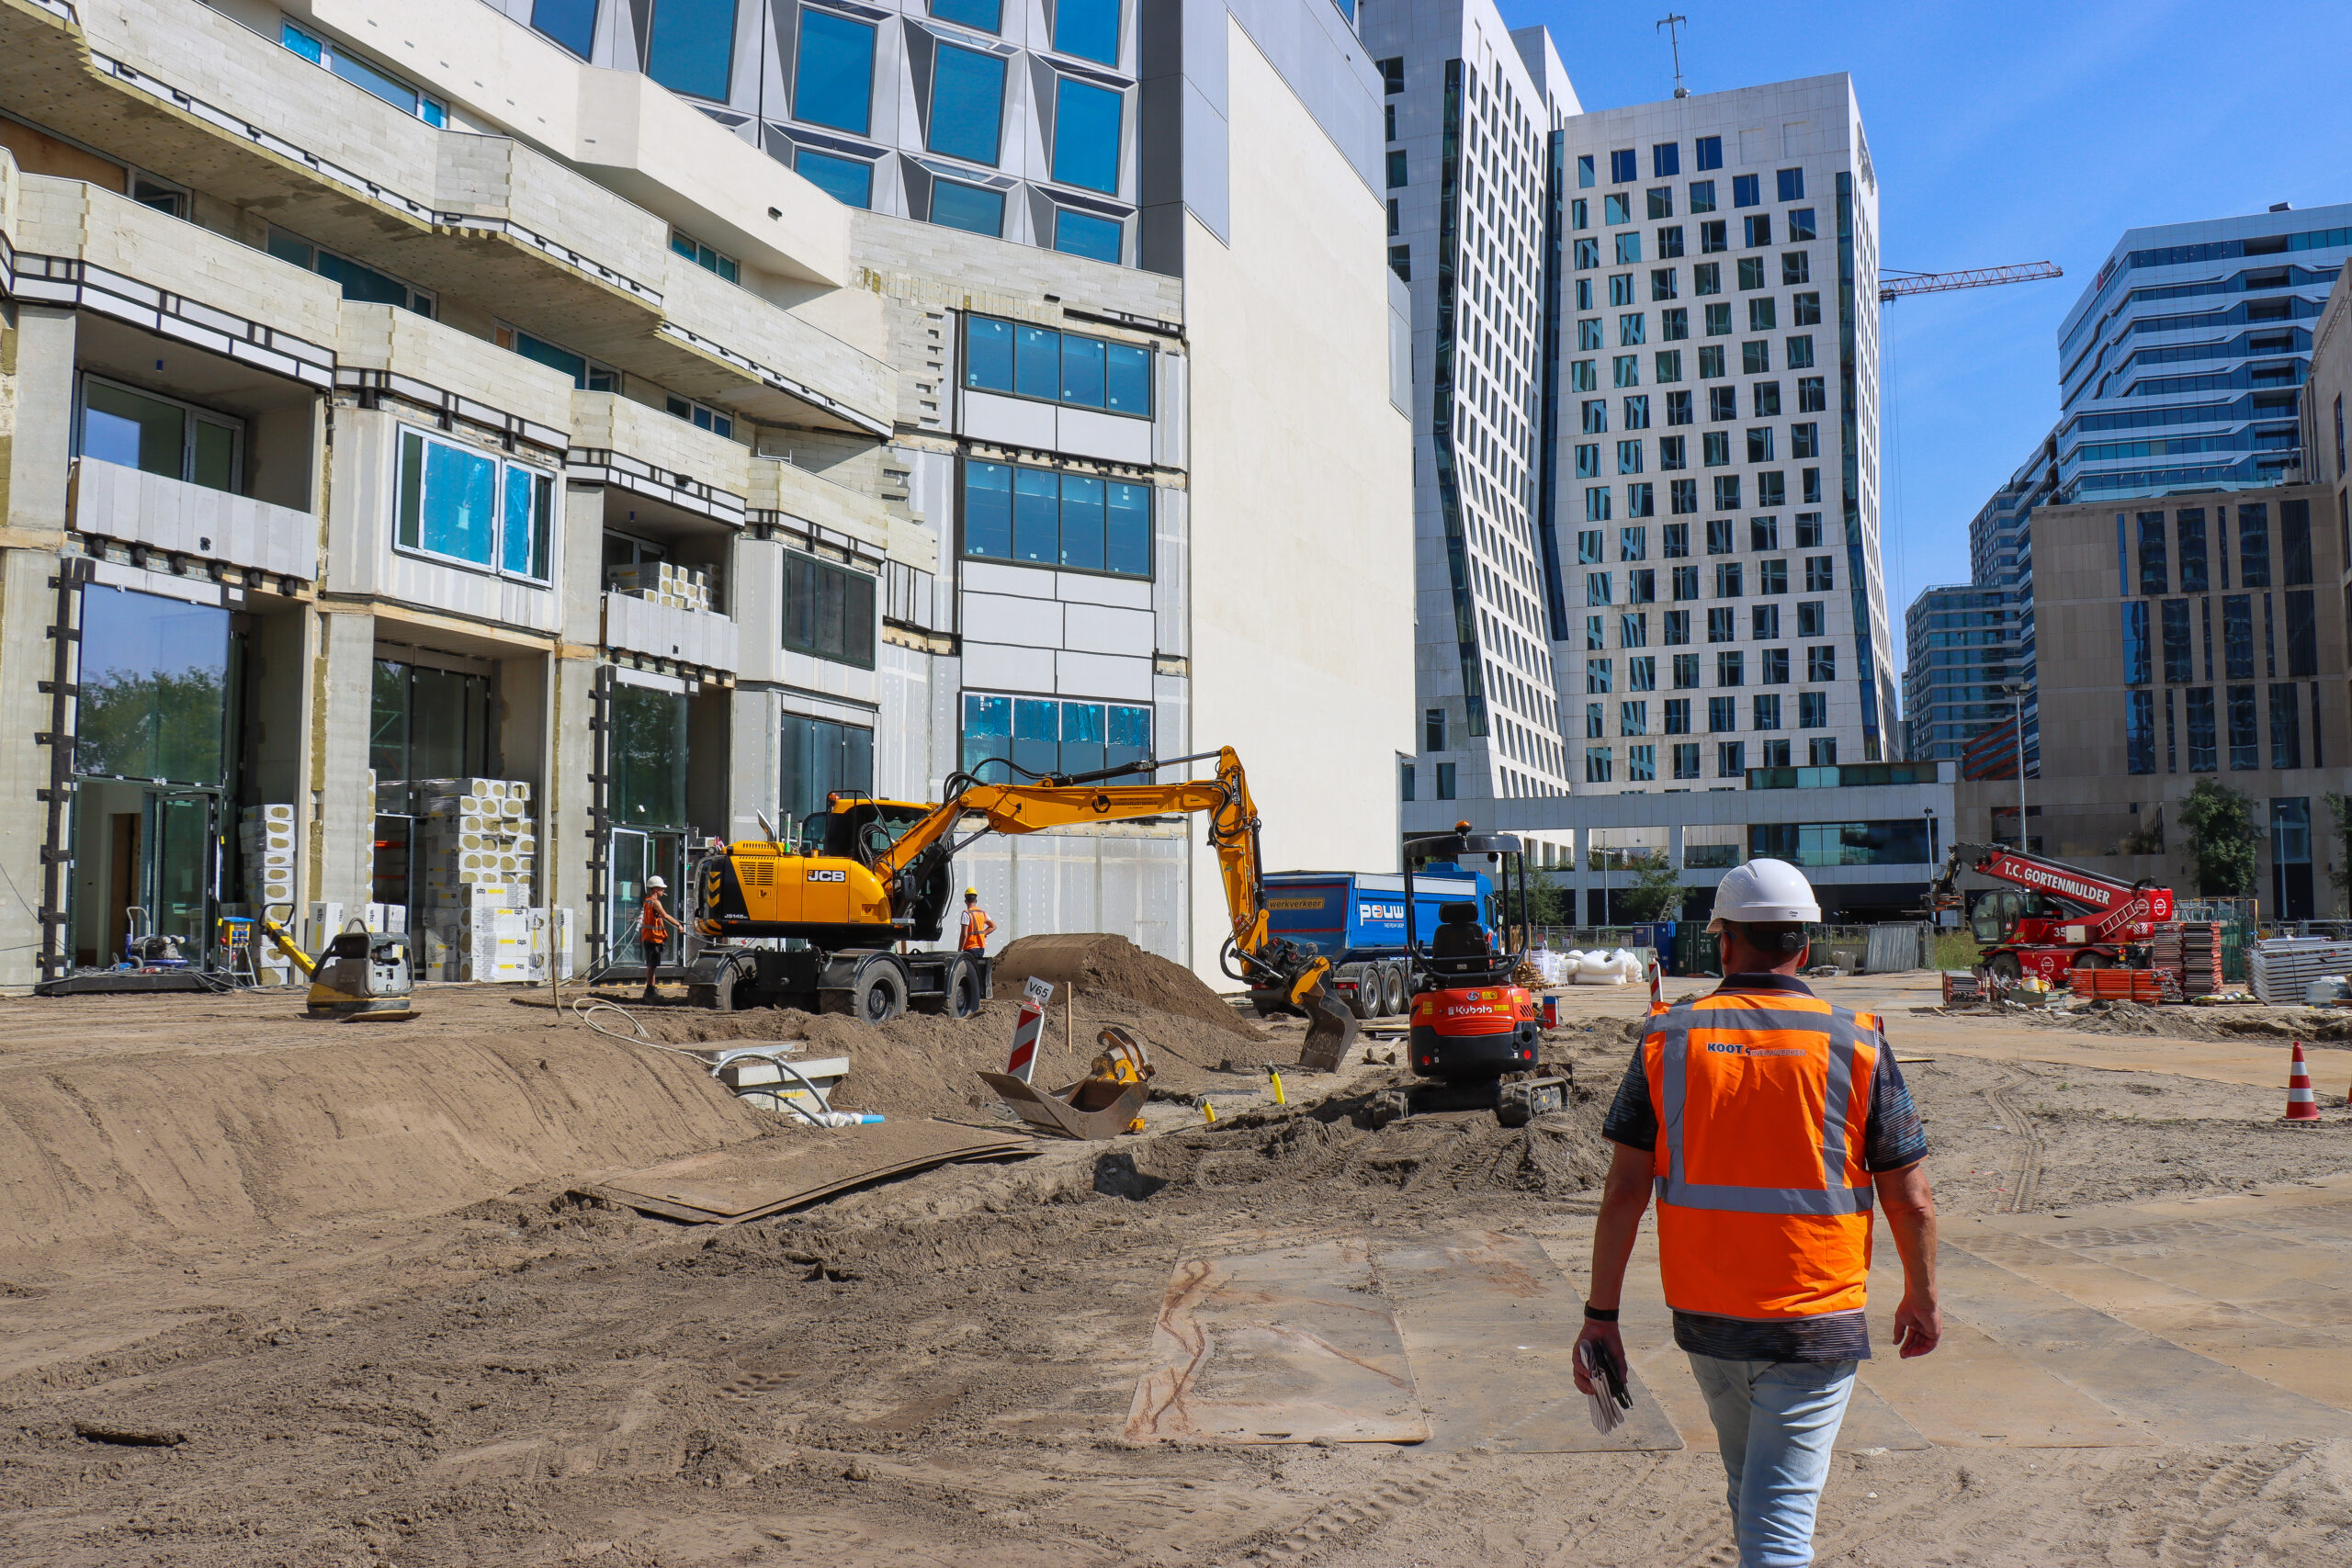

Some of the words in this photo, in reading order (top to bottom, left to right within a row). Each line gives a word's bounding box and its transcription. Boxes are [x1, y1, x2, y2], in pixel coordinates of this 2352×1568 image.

[808, 870, 845, 882] JCB
[2005, 862, 2023, 879] T.C.
[2024, 867, 2110, 905] GORTENMULDER
[1269, 900, 1322, 908] werkverkeer
[1029, 981, 1049, 998] V65
[1455, 1005, 1493, 1014] Kubota
[1707, 1043, 1744, 1055] KOOT
